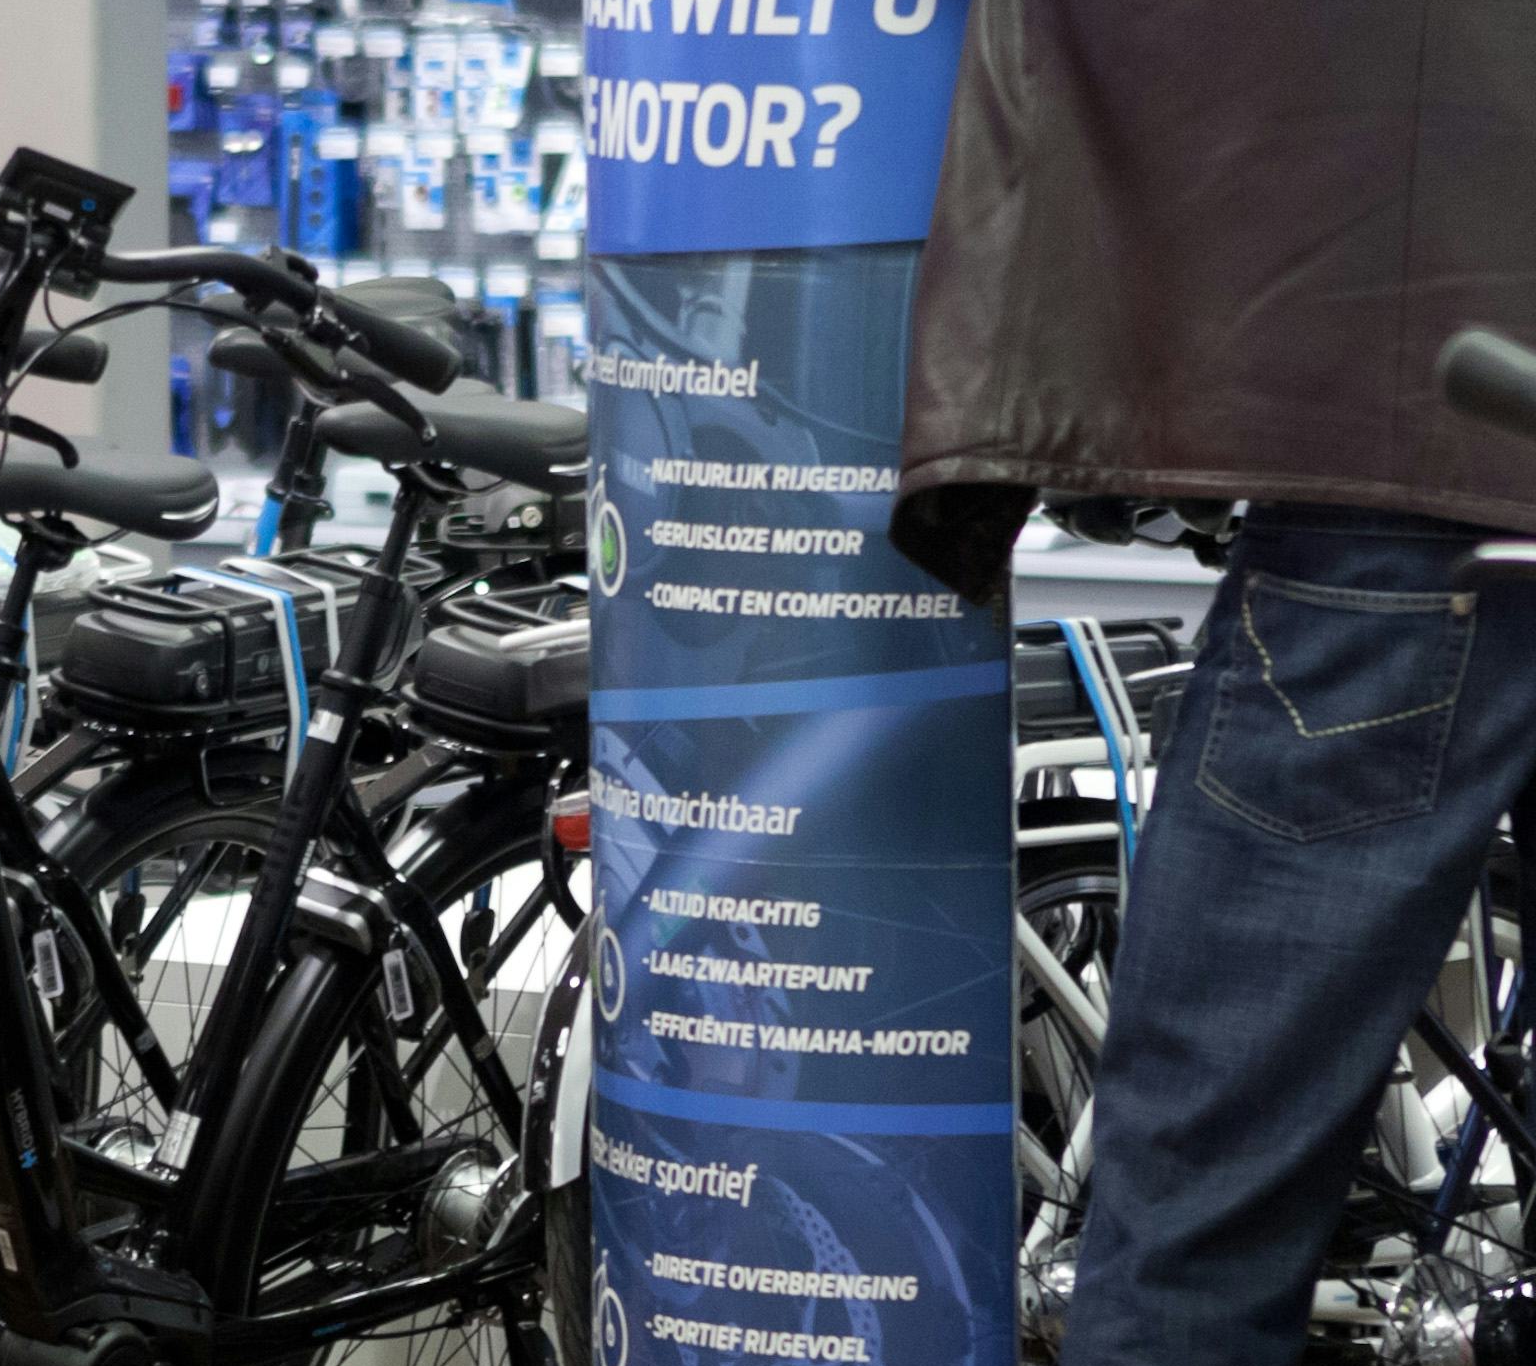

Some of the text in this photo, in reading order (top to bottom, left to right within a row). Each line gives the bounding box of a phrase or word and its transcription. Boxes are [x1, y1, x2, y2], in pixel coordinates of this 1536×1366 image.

[600, 79, 862, 168] MOTOR?
[619, 353, 759, 398] comfortabel
[771, 528, 865, 556] MOTOR
[740, 590, 773, 616] EN
[775, 591, 964, 619] COMFORTABEL
[642, 790, 803, 836] onzichtbaar
[707, 894, 821, 928] KRACHTIG
[696, 955, 873, 992] ZWAARTEPUNT
[757, 1025, 970, 1055] YAMAHA-MOTOR
[655, 1161, 759, 1208] sportief
[729, 1265, 919, 1302] OVERBRENGING
[744, 1328, 871, 1363] RIJGEVOEL
